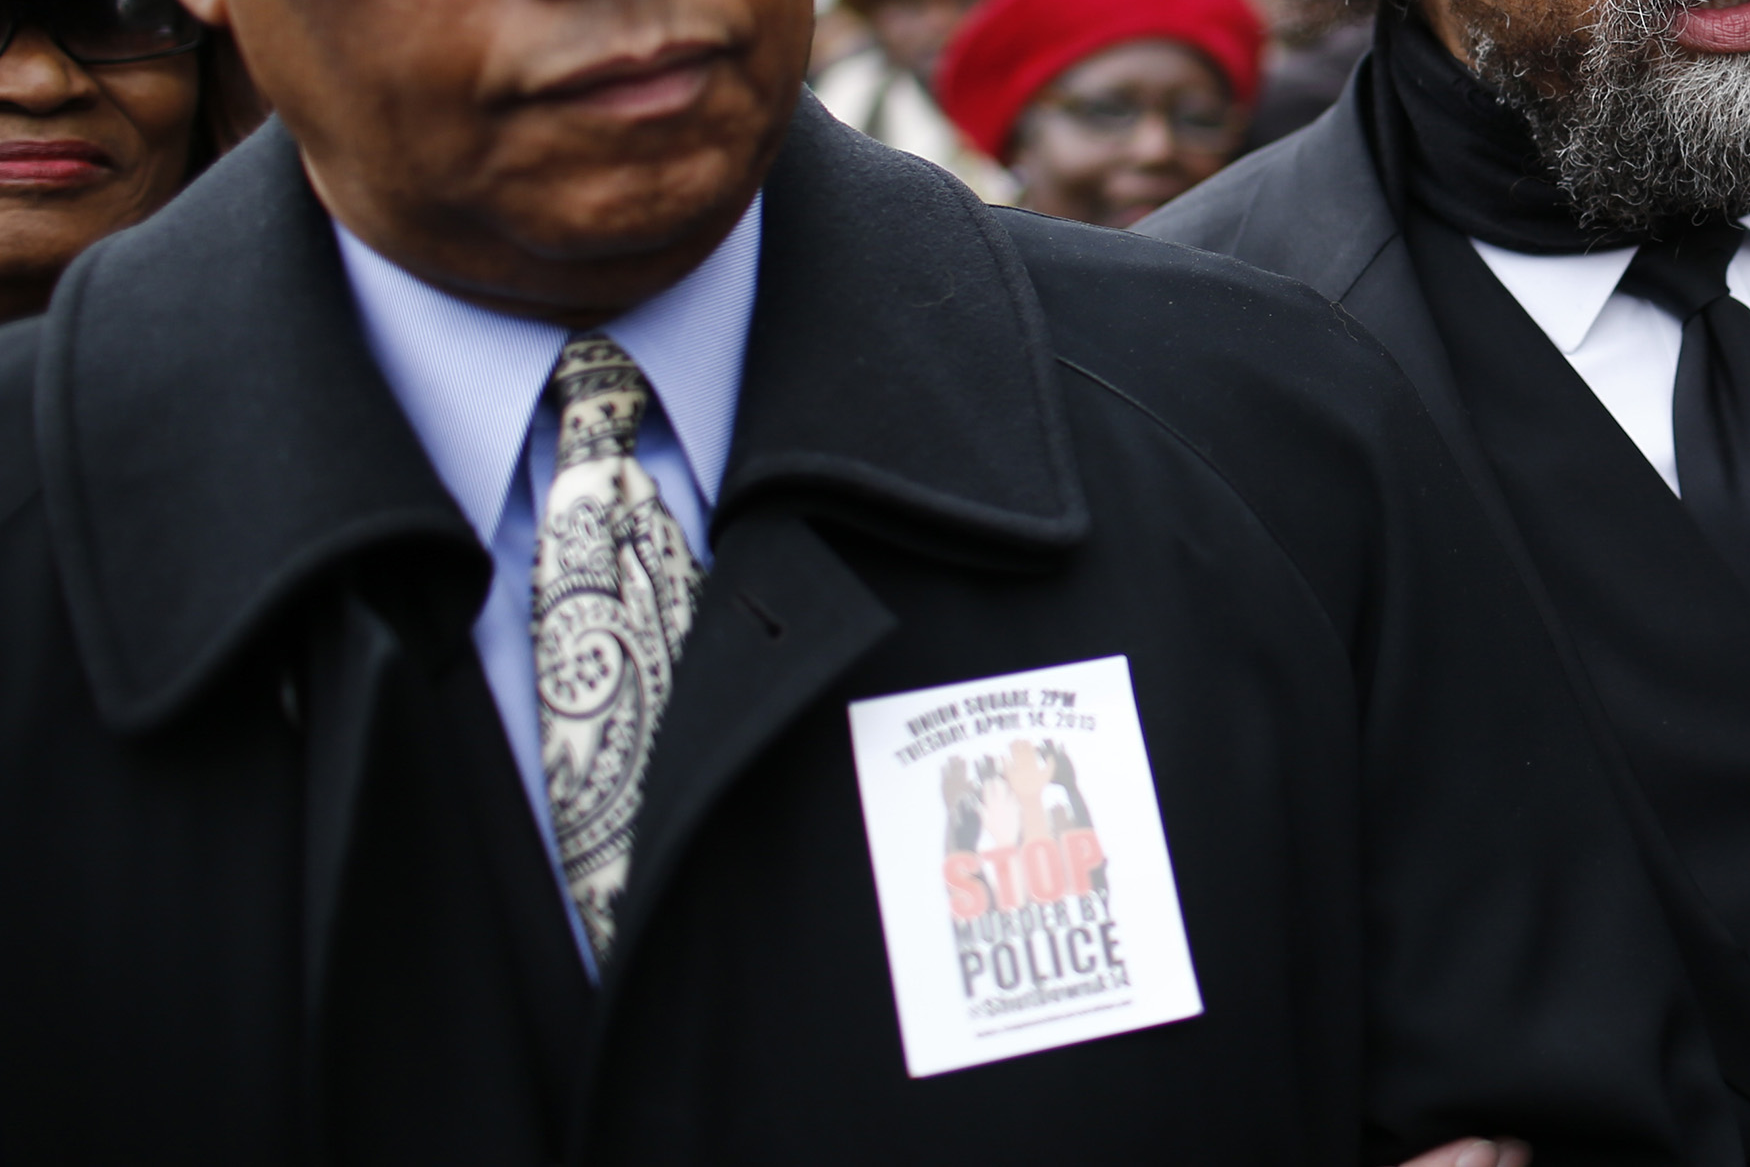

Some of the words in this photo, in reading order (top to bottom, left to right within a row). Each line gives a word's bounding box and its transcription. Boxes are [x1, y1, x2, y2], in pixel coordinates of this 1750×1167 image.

[942, 827, 1105, 920] STOP
[952, 898, 1071, 944] MURDER
[1079, 884, 1112, 924] BY
[958, 920, 1126, 998] POLICE
